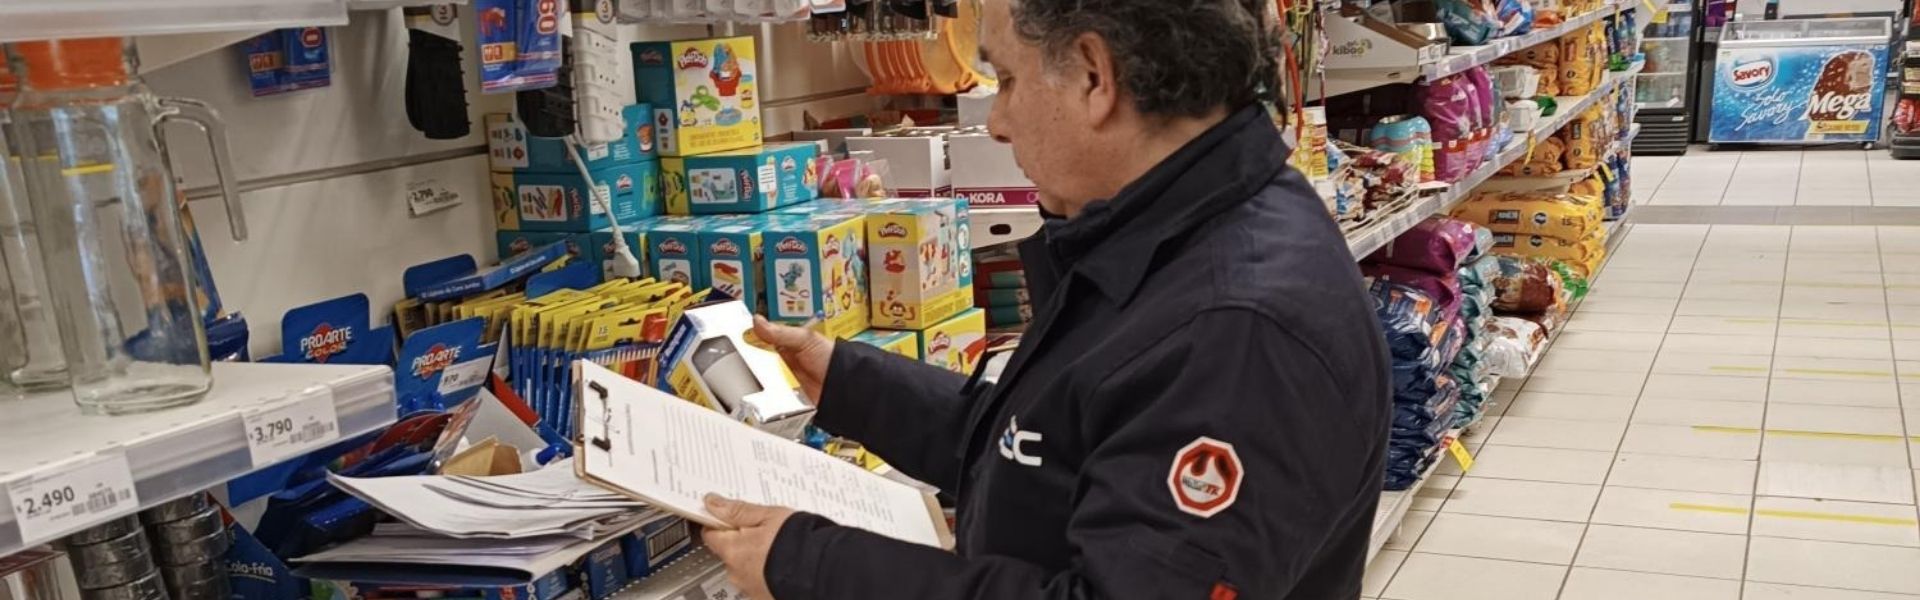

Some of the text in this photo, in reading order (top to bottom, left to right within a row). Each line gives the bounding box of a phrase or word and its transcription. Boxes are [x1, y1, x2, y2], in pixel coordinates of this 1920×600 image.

[1332, 44, 1365, 56] kiboo
[1733, 65, 1770, 82] Savory
[1735, 101, 1802, 131] Savory
[1798, 91, 1872, 121] Mega
[300, 326, 352, 352] PROARTE
[254, 417, 293, 442] 3.790
[23, 486, 75, 515] 2.490
